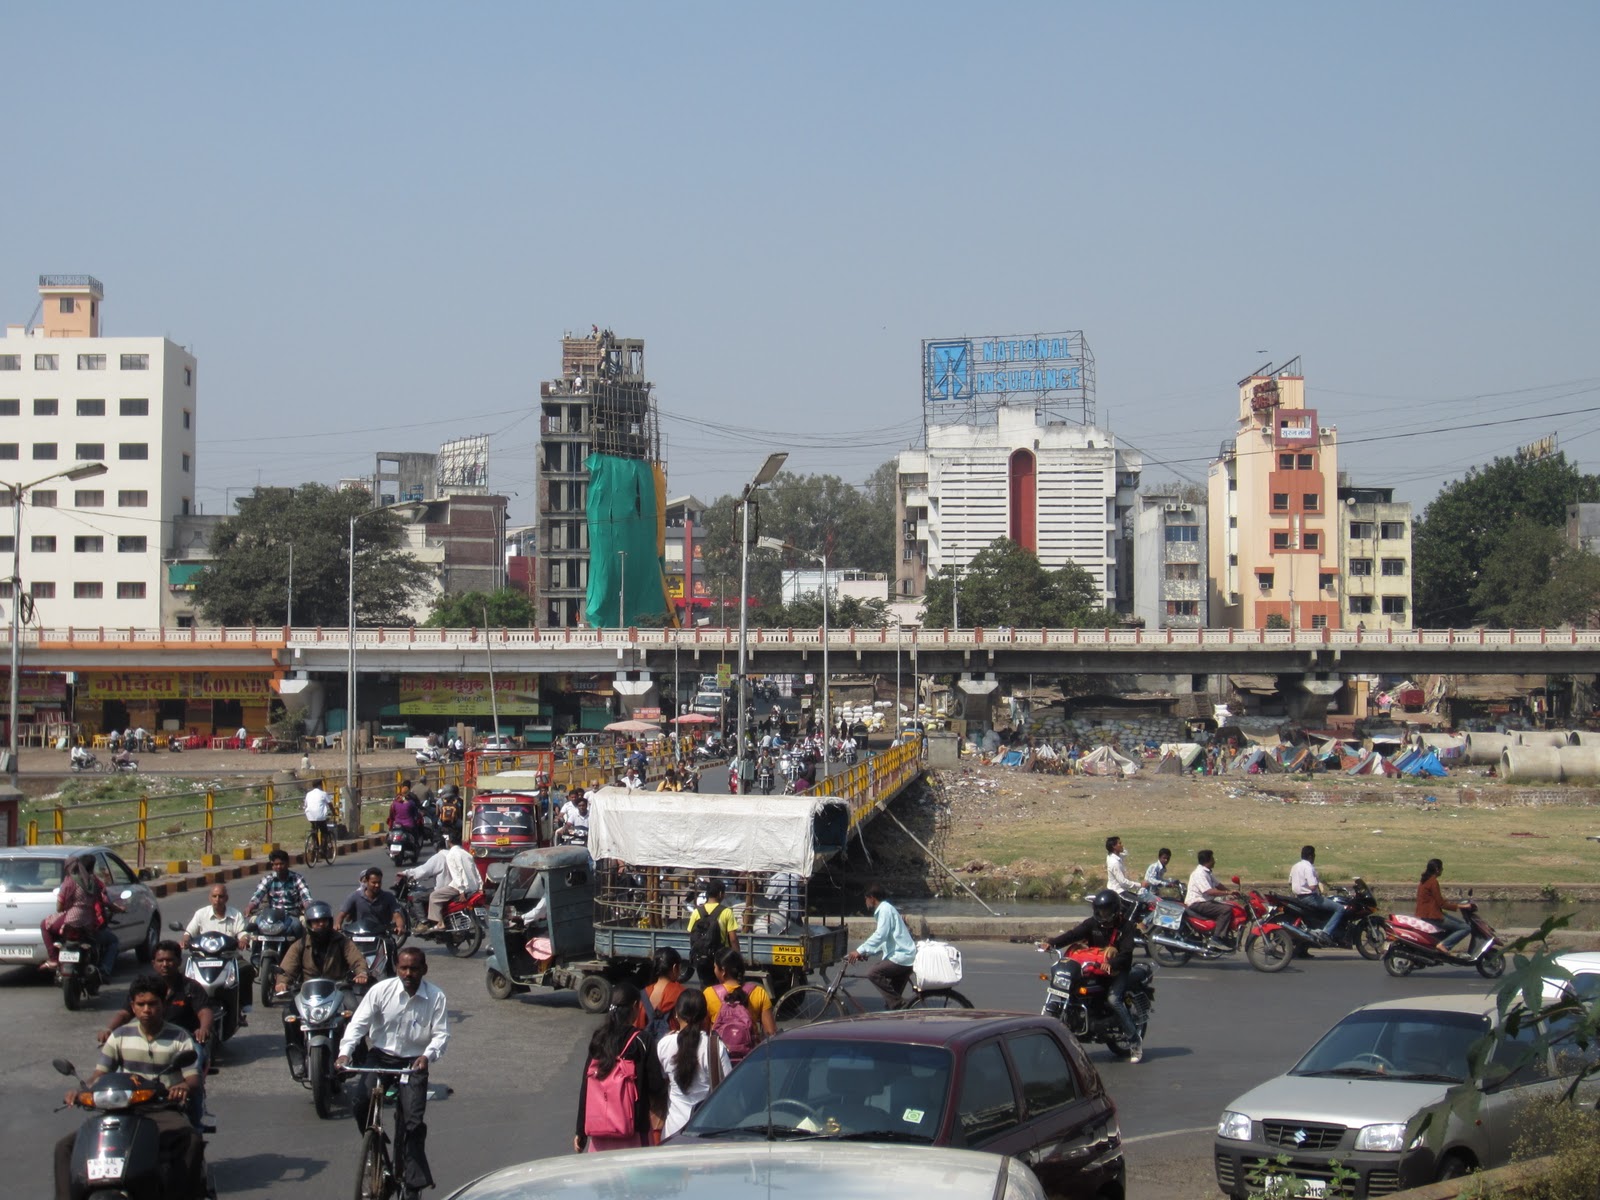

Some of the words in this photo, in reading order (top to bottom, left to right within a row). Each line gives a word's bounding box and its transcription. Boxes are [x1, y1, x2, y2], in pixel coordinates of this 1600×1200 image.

[983, 337, 1072, 362] NATIONAL
[977, 367, 1080, 393] INSURANCE
[775, 955, 801, 963] 2569
